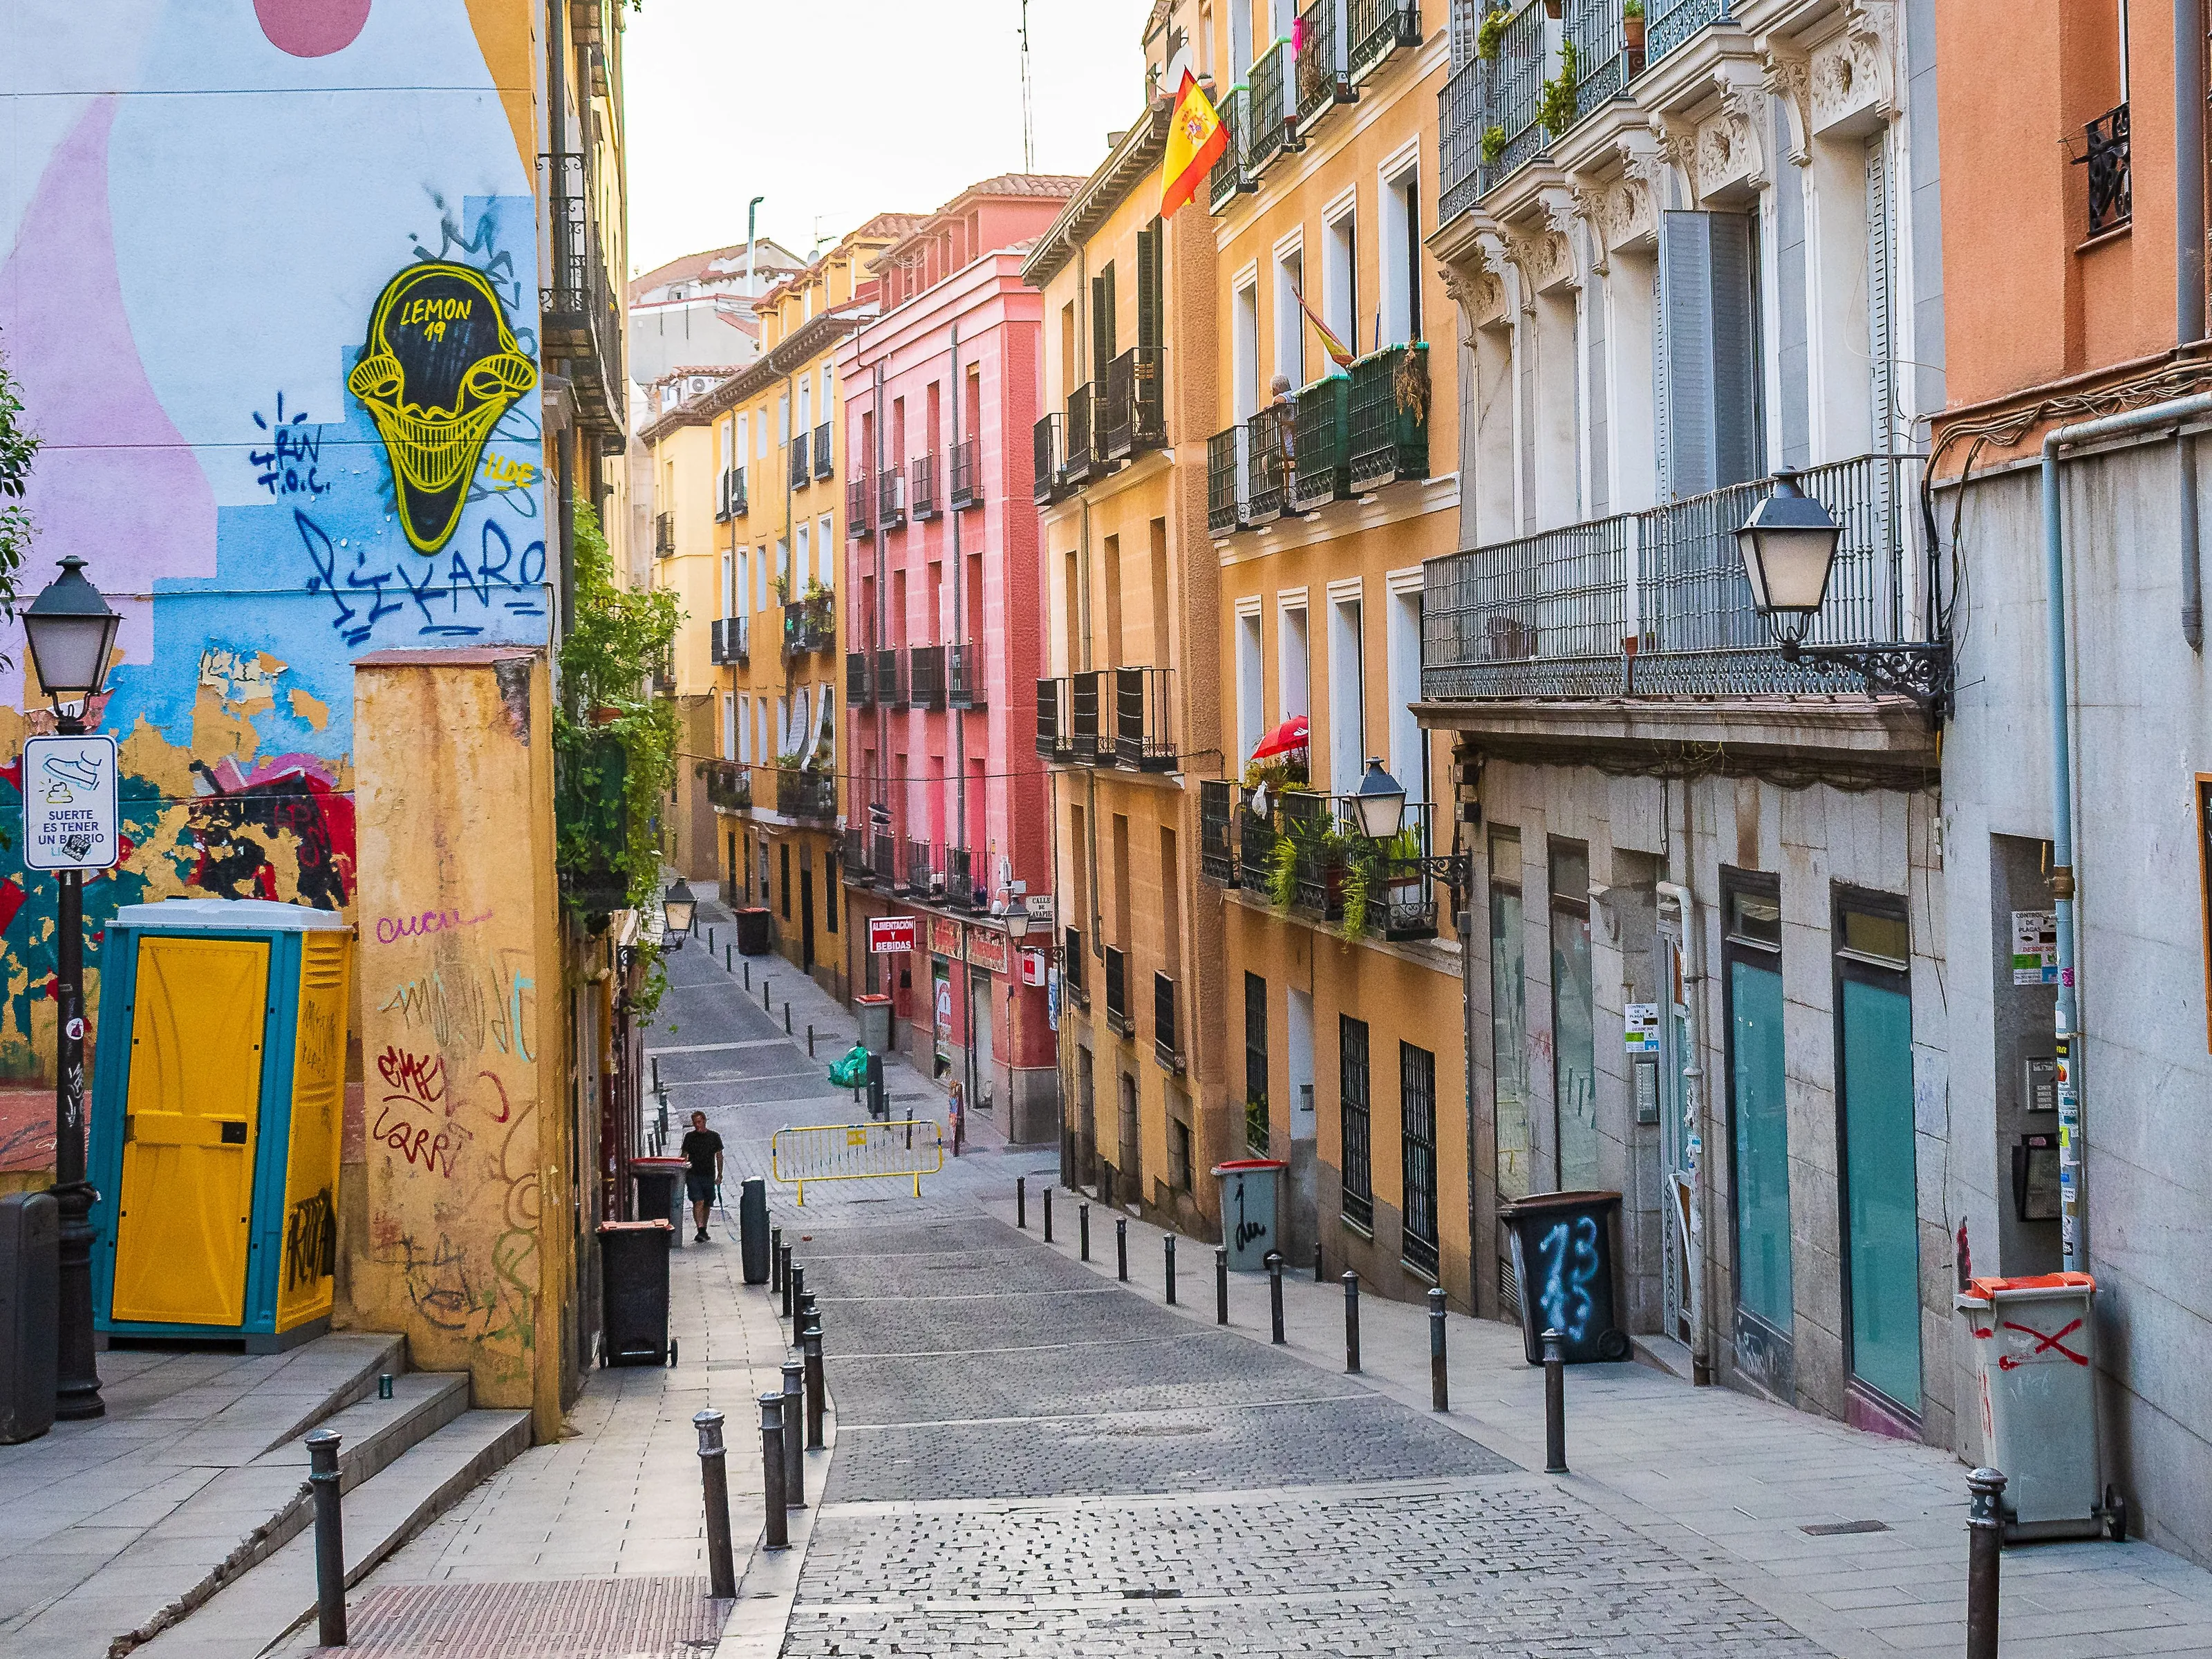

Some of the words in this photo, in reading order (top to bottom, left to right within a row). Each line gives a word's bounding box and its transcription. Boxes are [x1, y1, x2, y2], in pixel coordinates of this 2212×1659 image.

[400, 298, 473, 326] LEMON
[424, 321, 447, 342] 19
[48, 809, 93, 821] SUERTE
[43, 823, 57, 832] ES
[60, 821, 99, 832] TENER
[38, 834, 55, 845] UN
[59, 833, 104, 844] BRIO
[872, 919, 914, 931] ALIMENTACIÓN
[890, 931, 896, 941] Y
[876, 940, 912, 951] BEBIDAS
